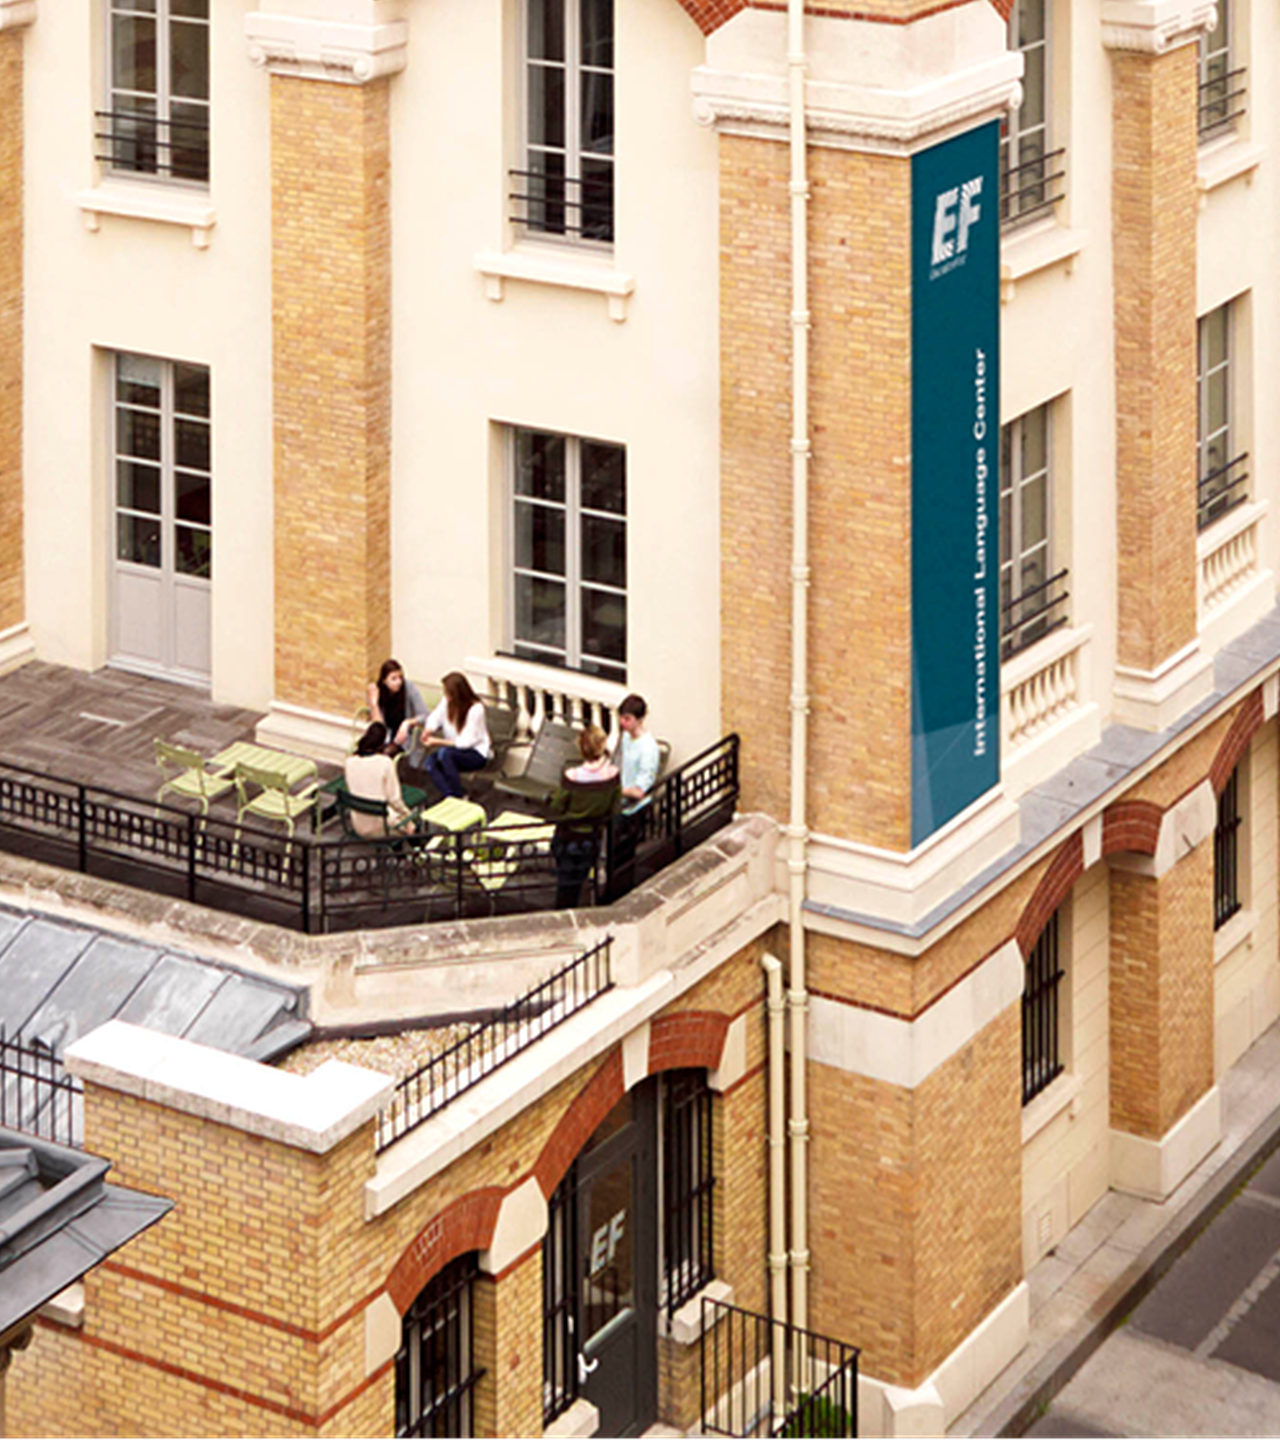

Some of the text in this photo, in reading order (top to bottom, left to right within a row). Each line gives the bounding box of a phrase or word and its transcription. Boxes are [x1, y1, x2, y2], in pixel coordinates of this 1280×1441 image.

[931, 175, 984, 266] EF
[973, 347, 988, 756] International Language Center
[590, 1207, 626, 1275] EF
